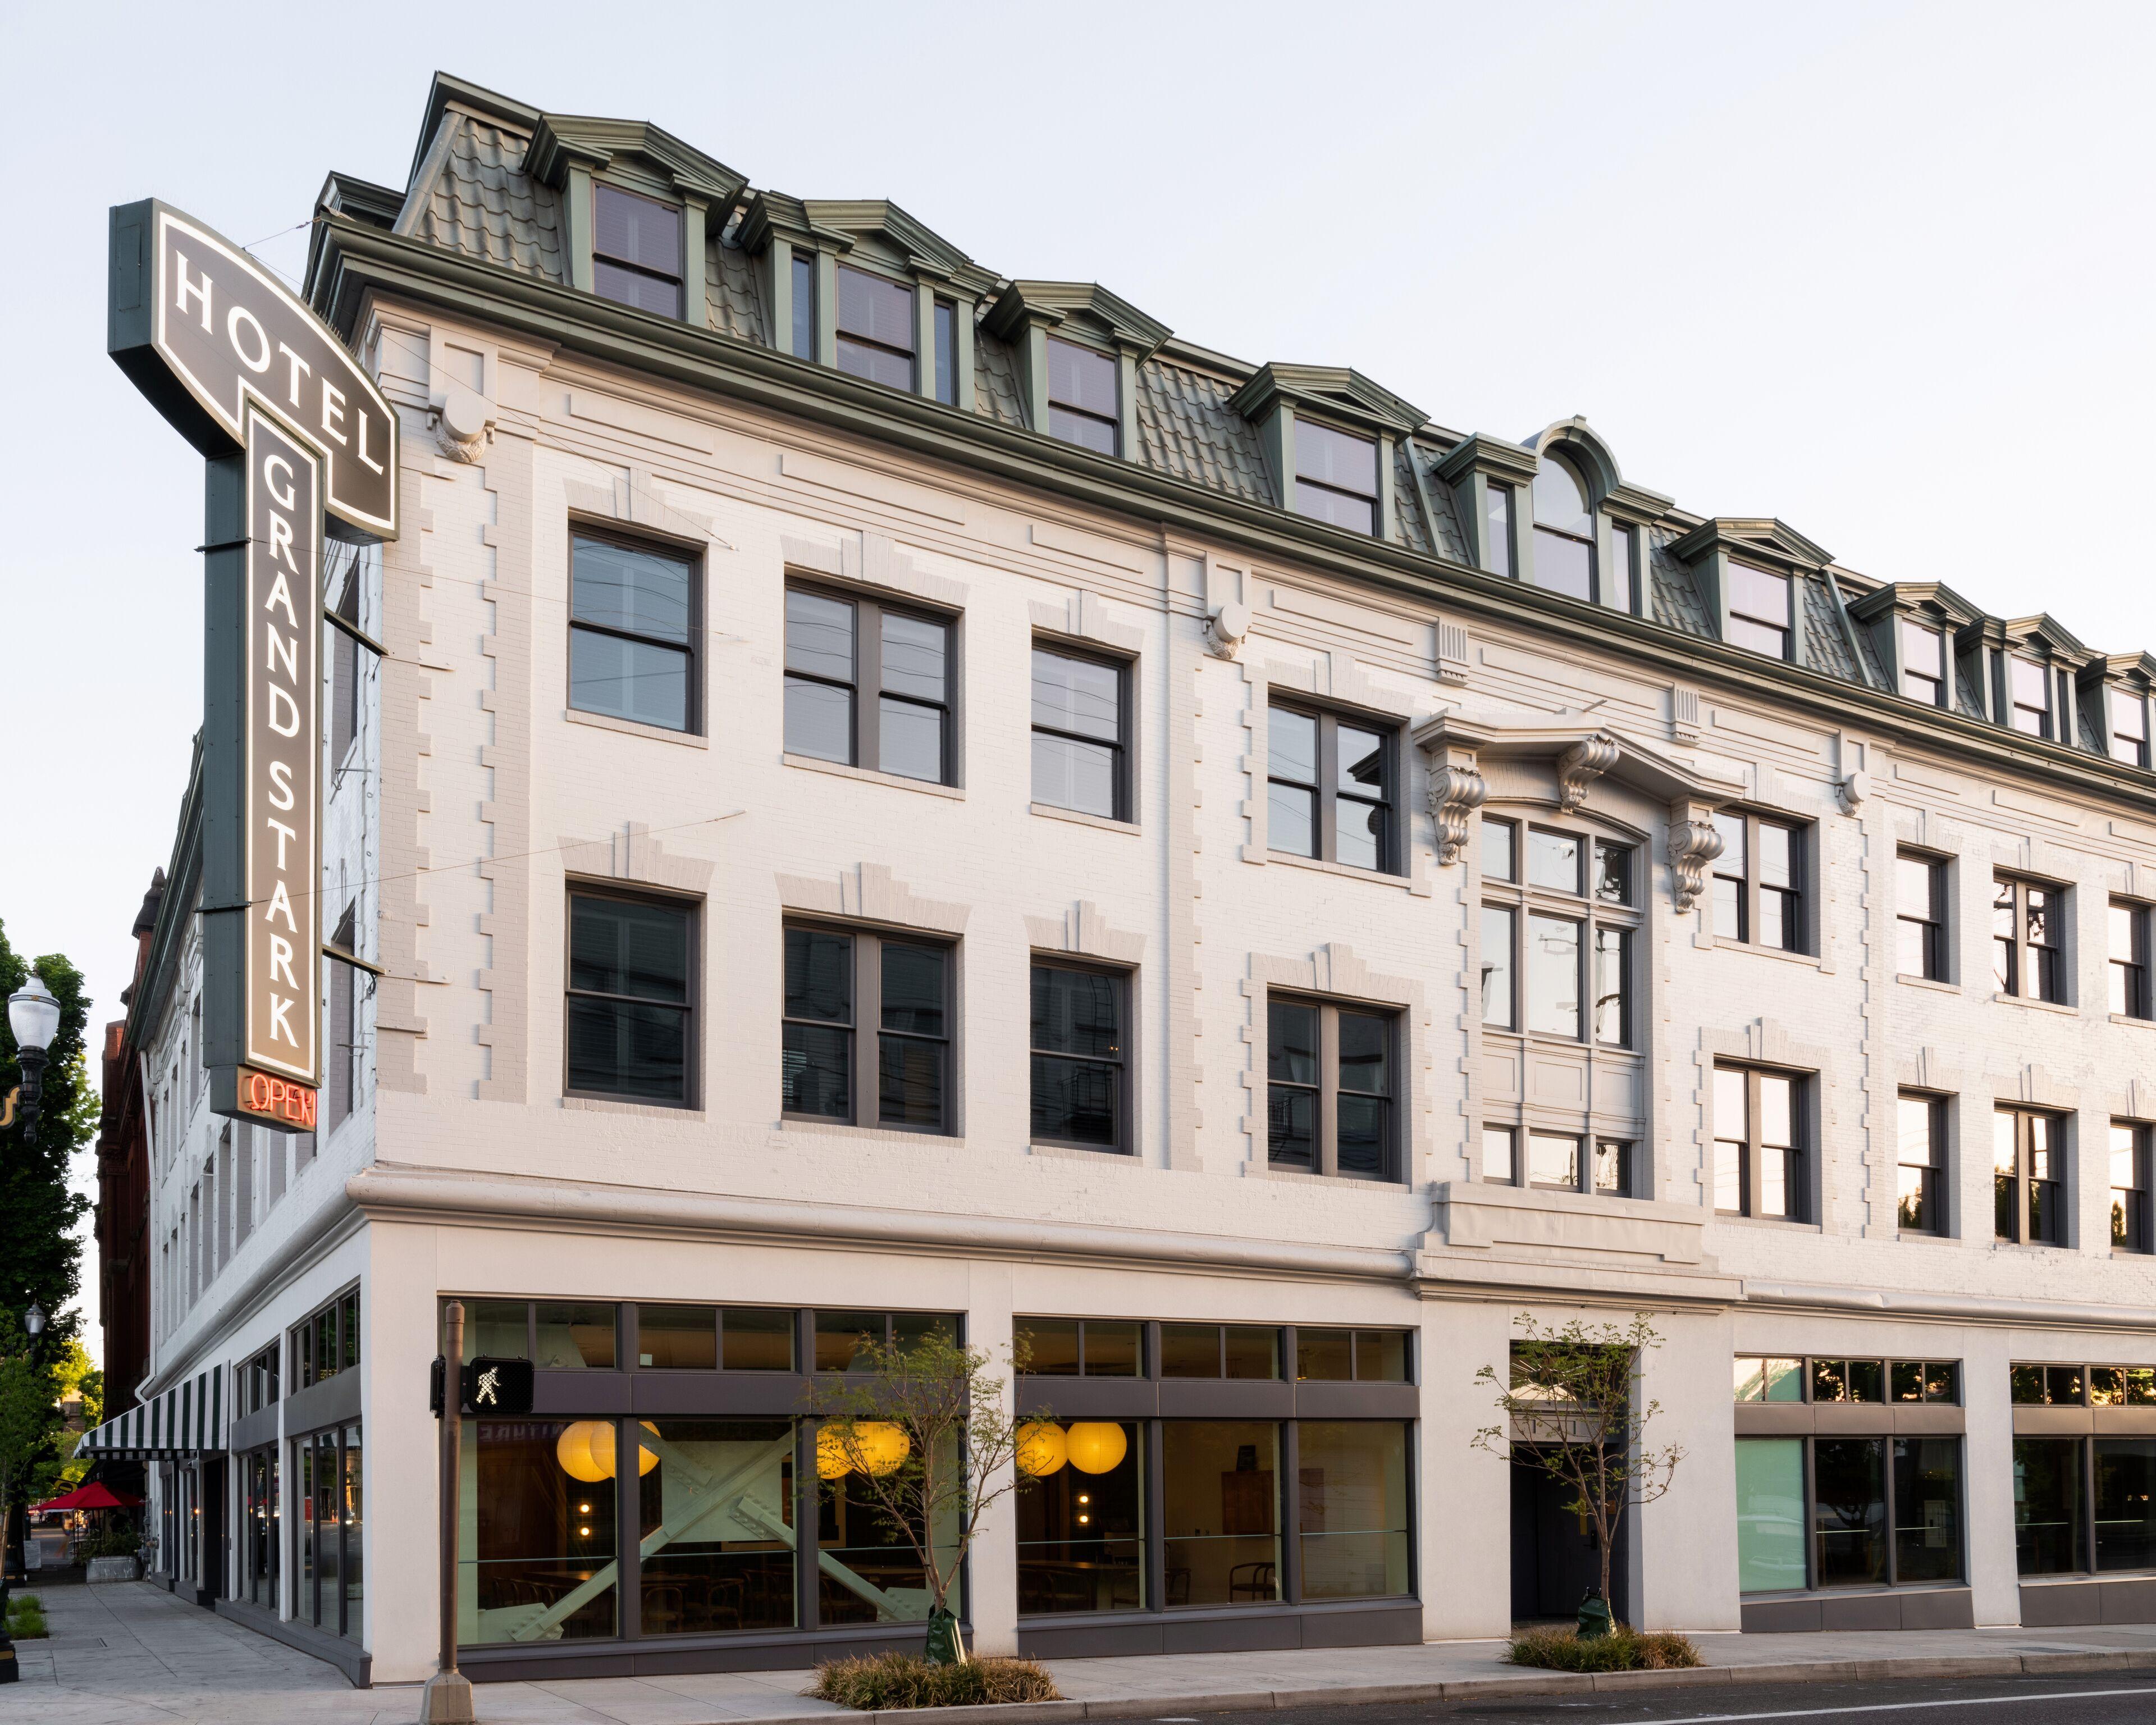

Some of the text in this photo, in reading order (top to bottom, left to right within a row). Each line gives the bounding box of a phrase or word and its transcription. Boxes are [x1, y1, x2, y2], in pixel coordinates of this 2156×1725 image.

[176, 250, 384, 476] HOTEL
[264, 454, 300, 1048] GRAND STARK
[250, 1073, 316, 1126] OPEN
